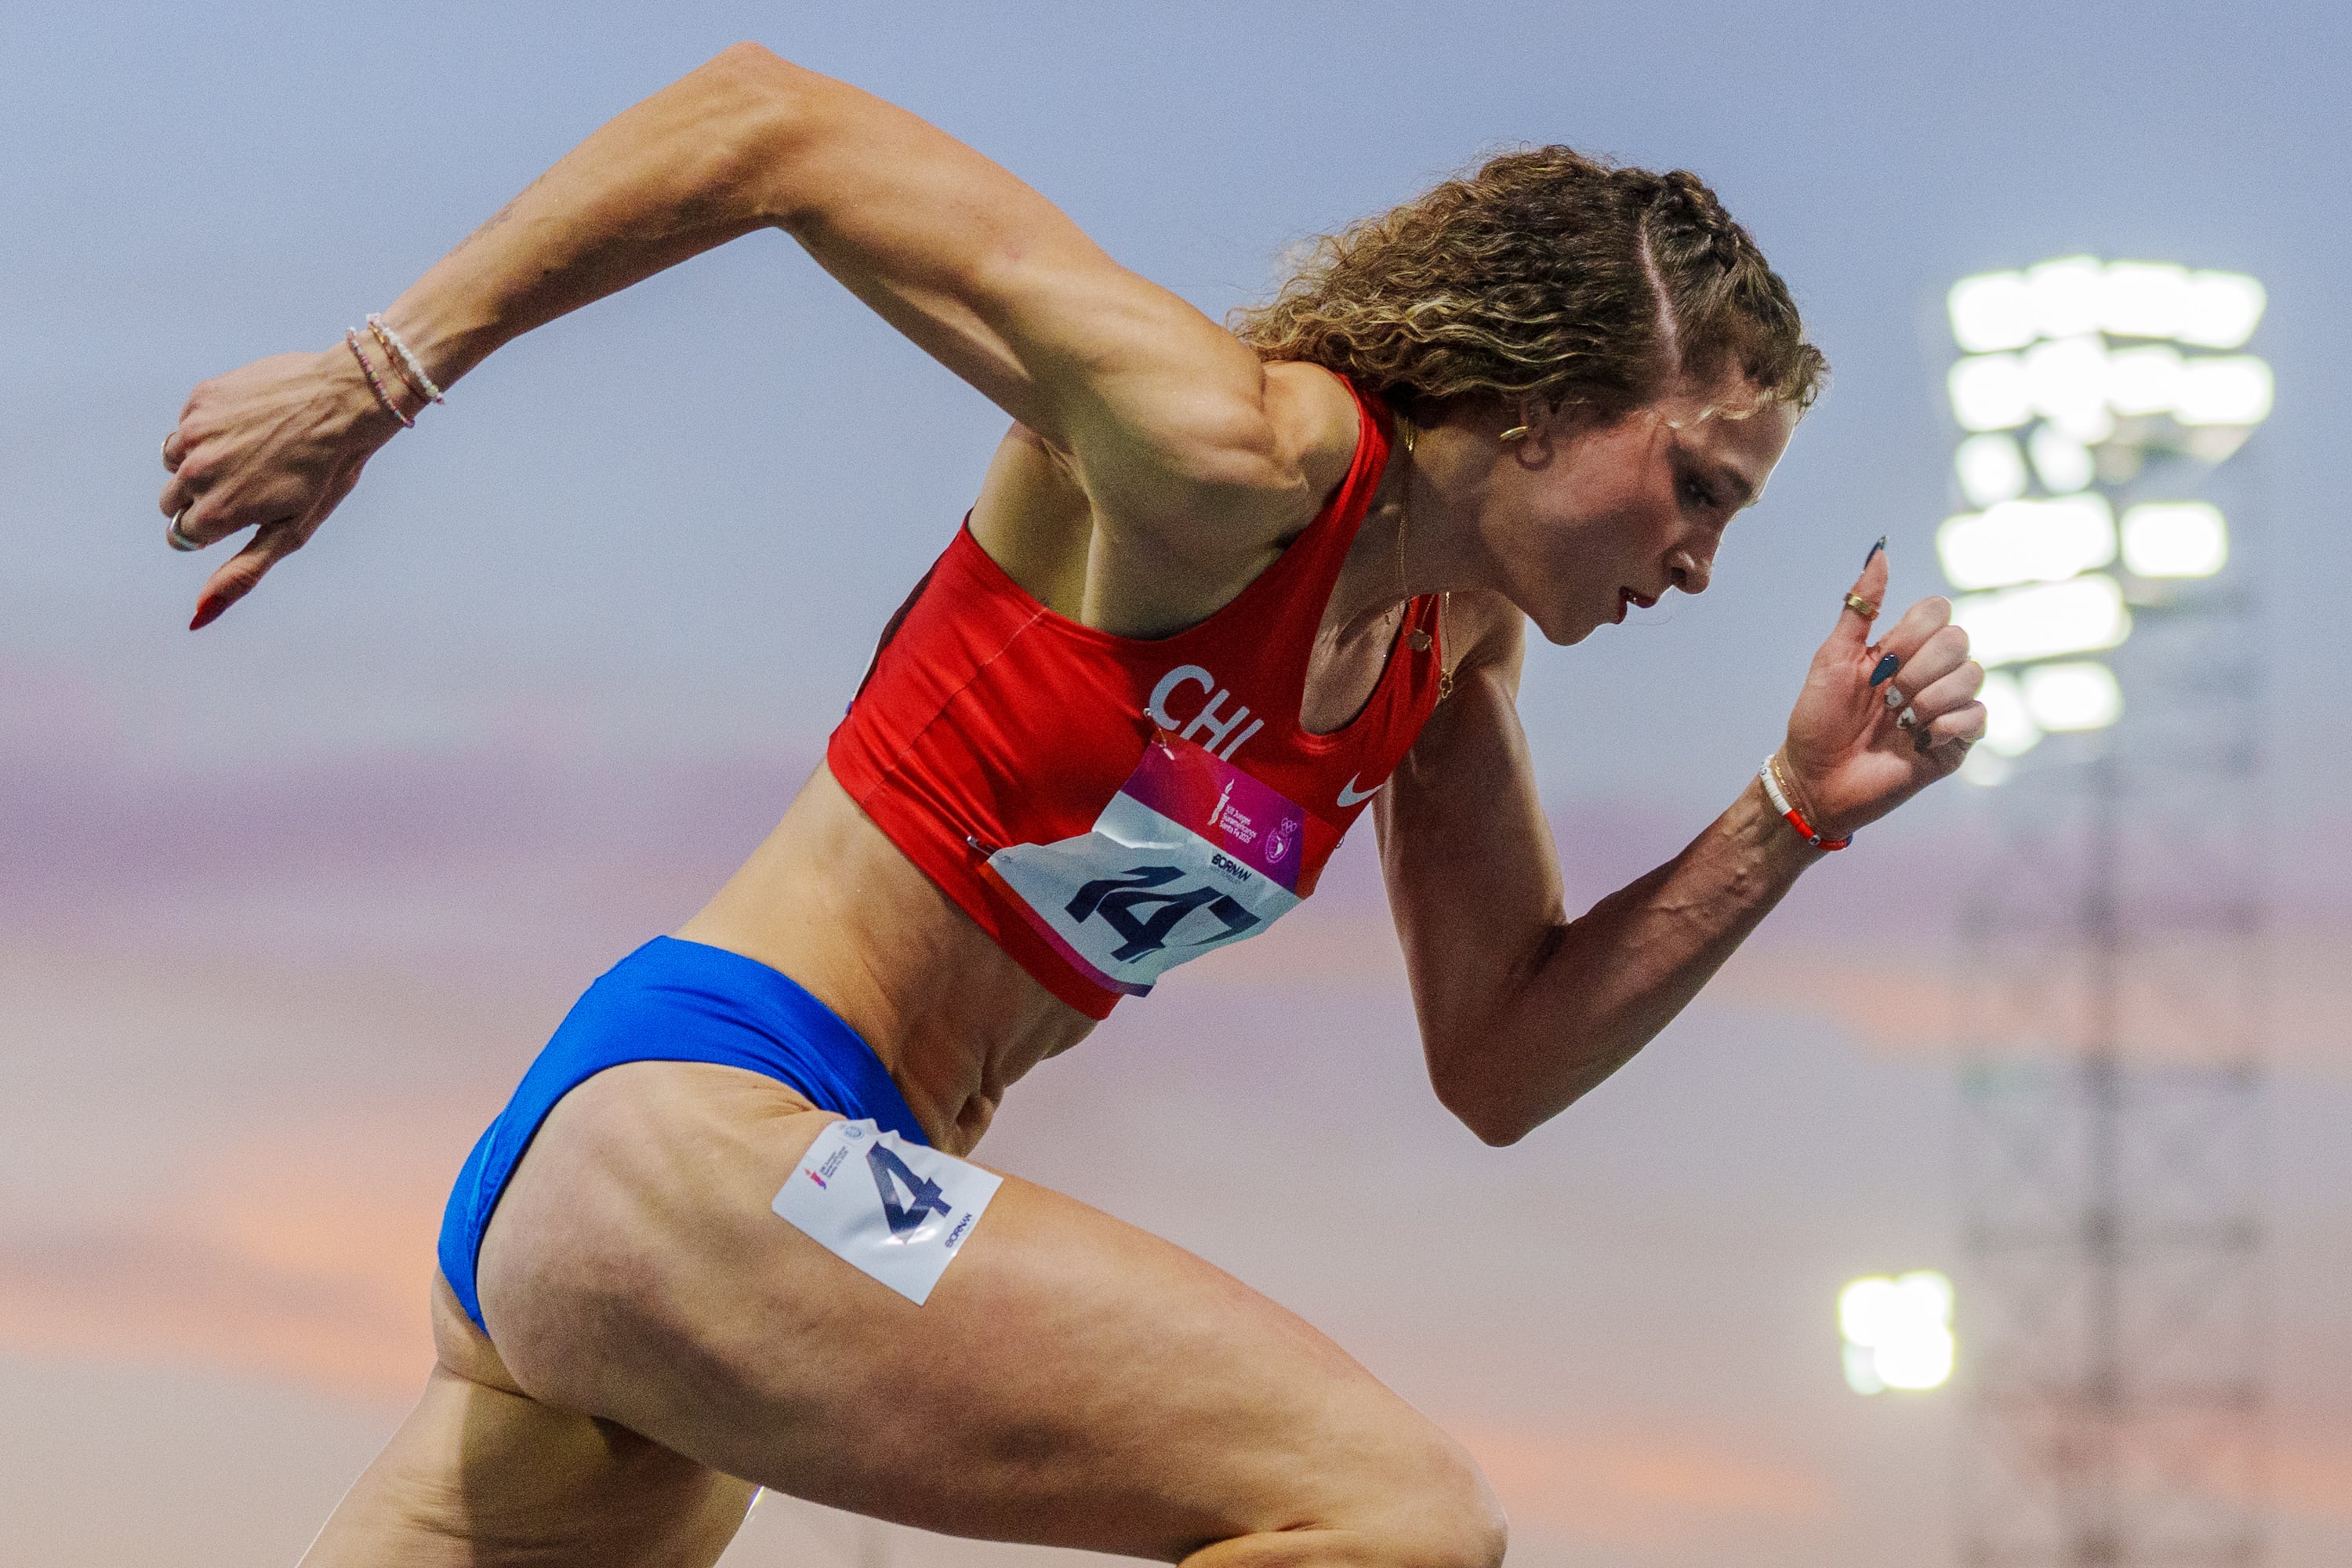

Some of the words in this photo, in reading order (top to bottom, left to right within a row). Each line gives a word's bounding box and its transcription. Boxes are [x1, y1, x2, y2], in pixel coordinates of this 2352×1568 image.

[1149, 665, 1264, 761] CHI
[1211, 854, 1252, 881] BORNAN
[866, 1141, 952, 1243] 4
[945, 1213, 972, 1248] BORNAN
